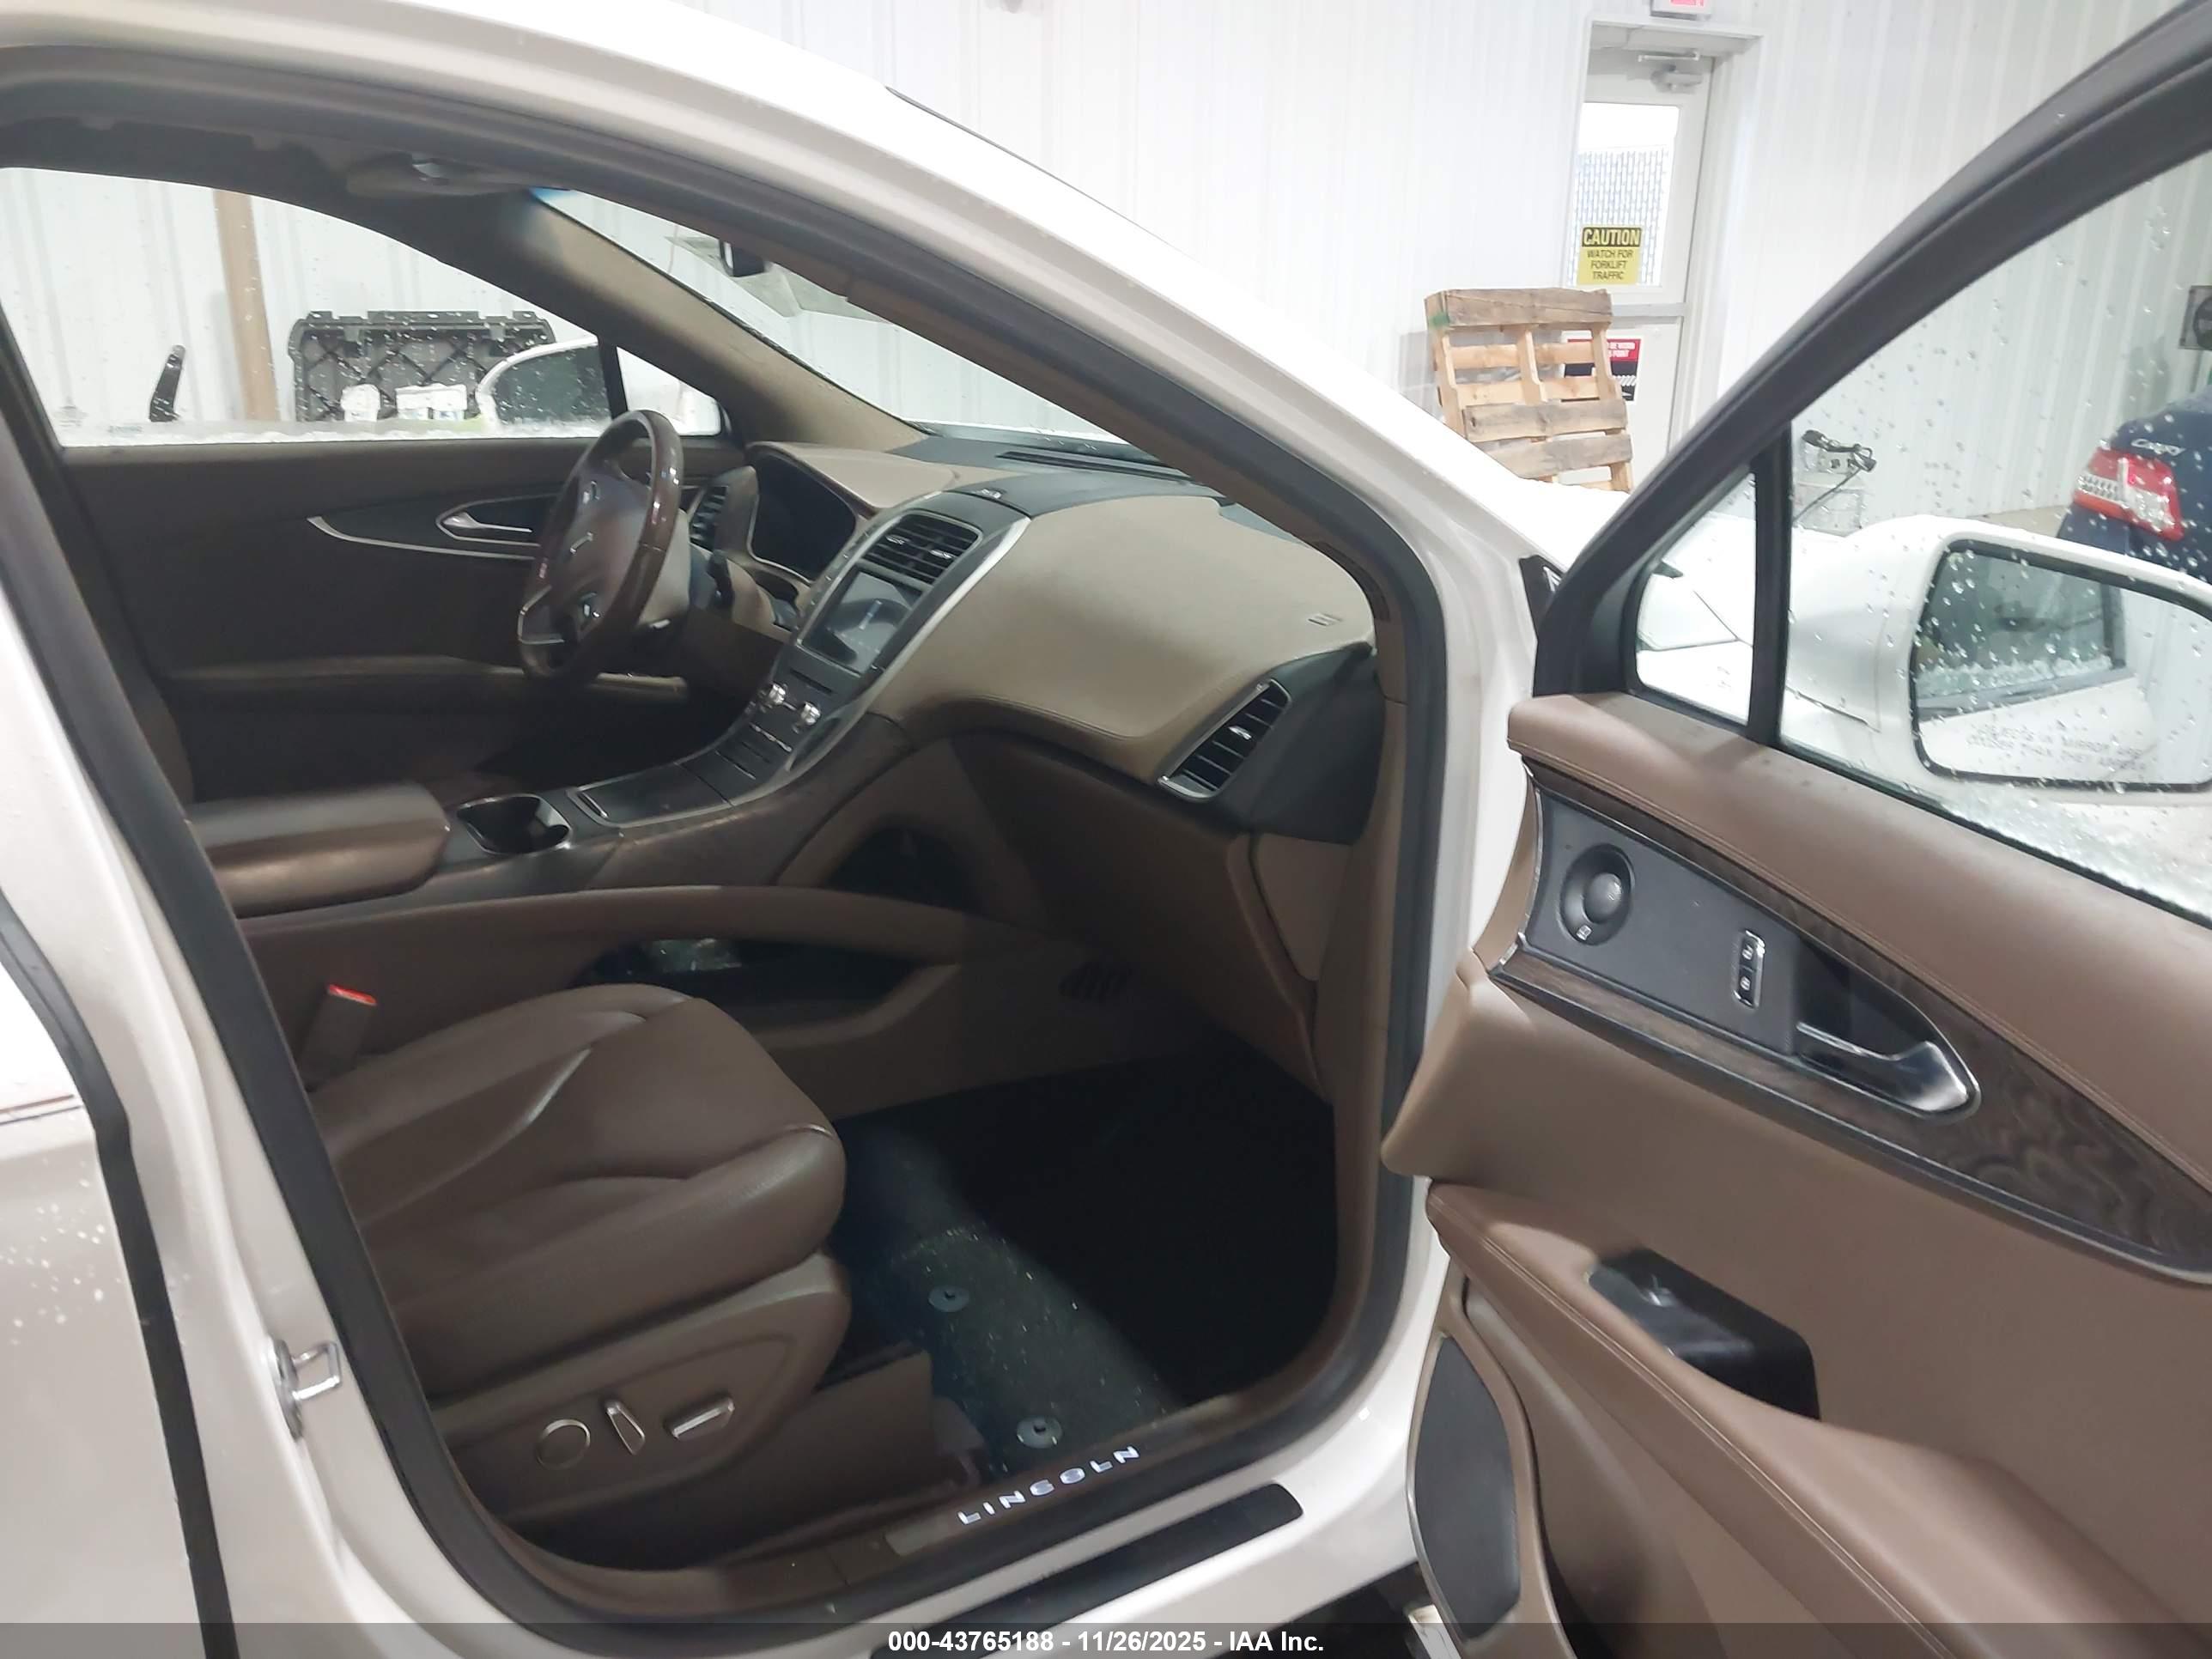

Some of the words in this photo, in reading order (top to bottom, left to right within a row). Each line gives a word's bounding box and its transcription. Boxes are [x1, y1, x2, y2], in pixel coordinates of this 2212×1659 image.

[1583, 228, 1640, 246] CAUTION
[1587, 249, 1615, 258] WATCH
[1618, 249, 1633, 258] FOR
[1591, 259, 1628, 269] FORKLIFT
[1593, 270, 1624, 280] TRAFFIC
[957, 1445, 1139, 1525] LINCOLN
